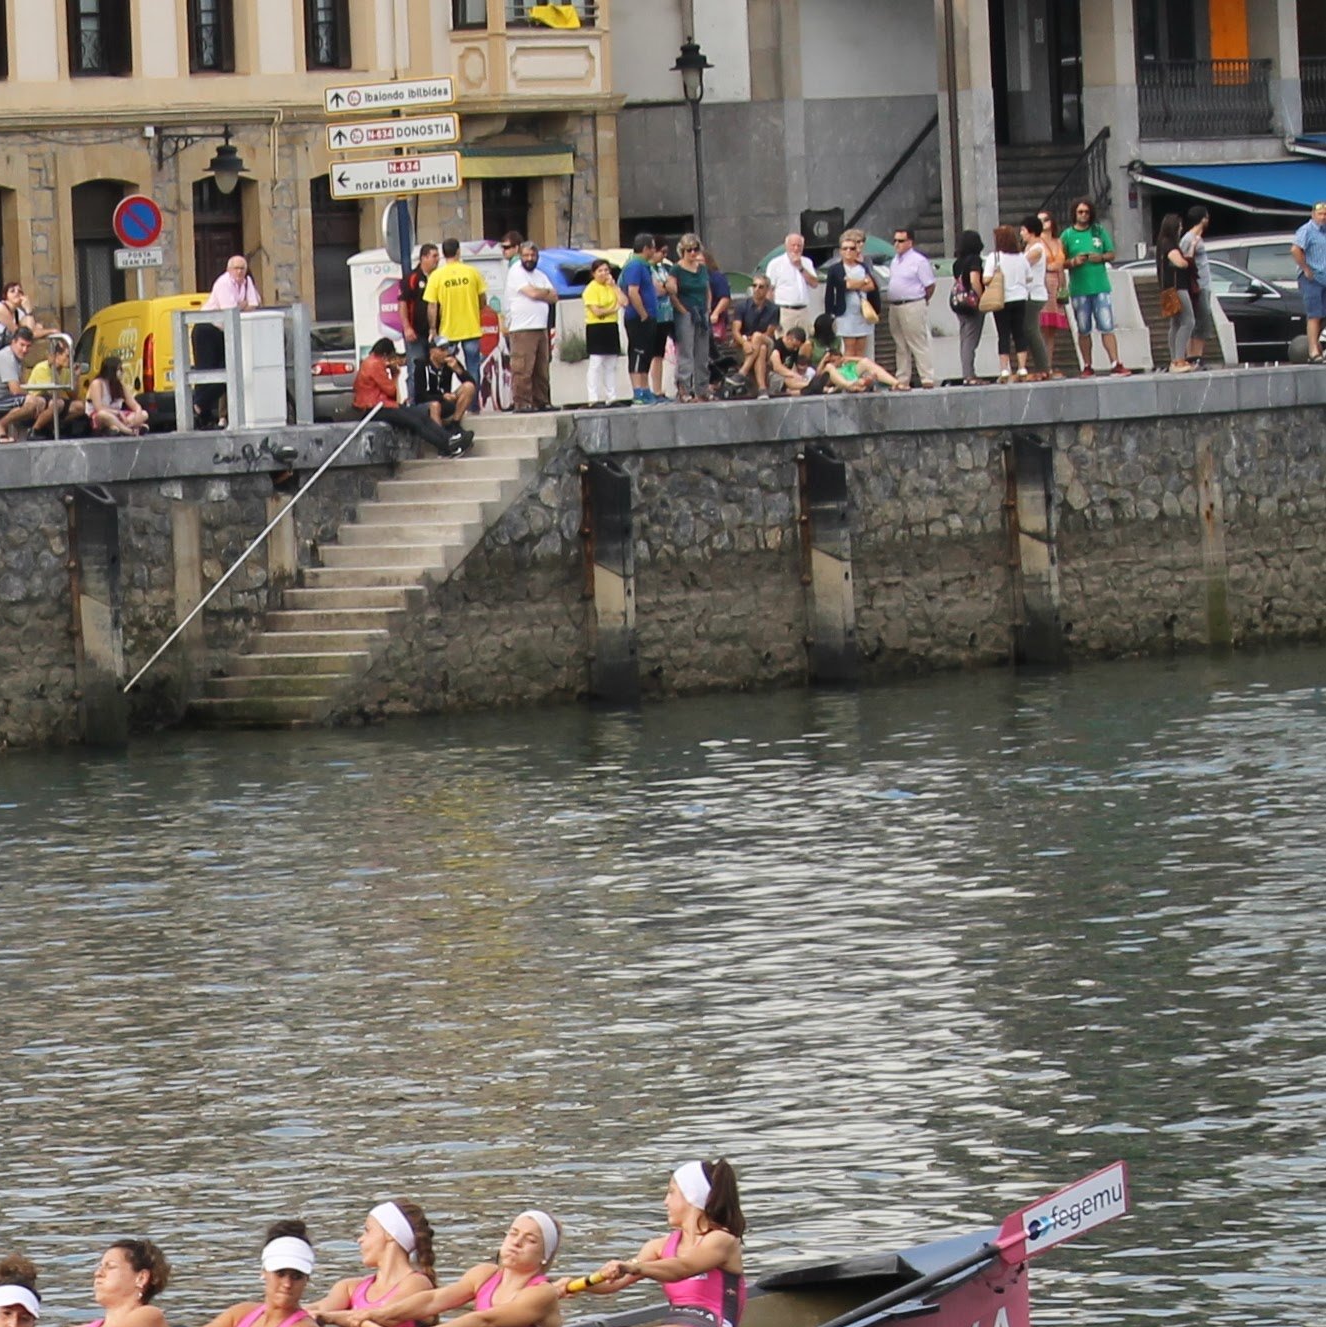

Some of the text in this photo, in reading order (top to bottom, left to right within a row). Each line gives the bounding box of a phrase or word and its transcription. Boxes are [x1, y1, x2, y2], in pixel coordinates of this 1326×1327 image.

[396, 123, 451, 138] DONOSTIA
[388, 161, 419, 173] N-634
[355, 173, 454, 190] norabide guztiak
[444, 277, 470, 288] ORIO
[1051, 1183, 1122, 1229] fegemu
